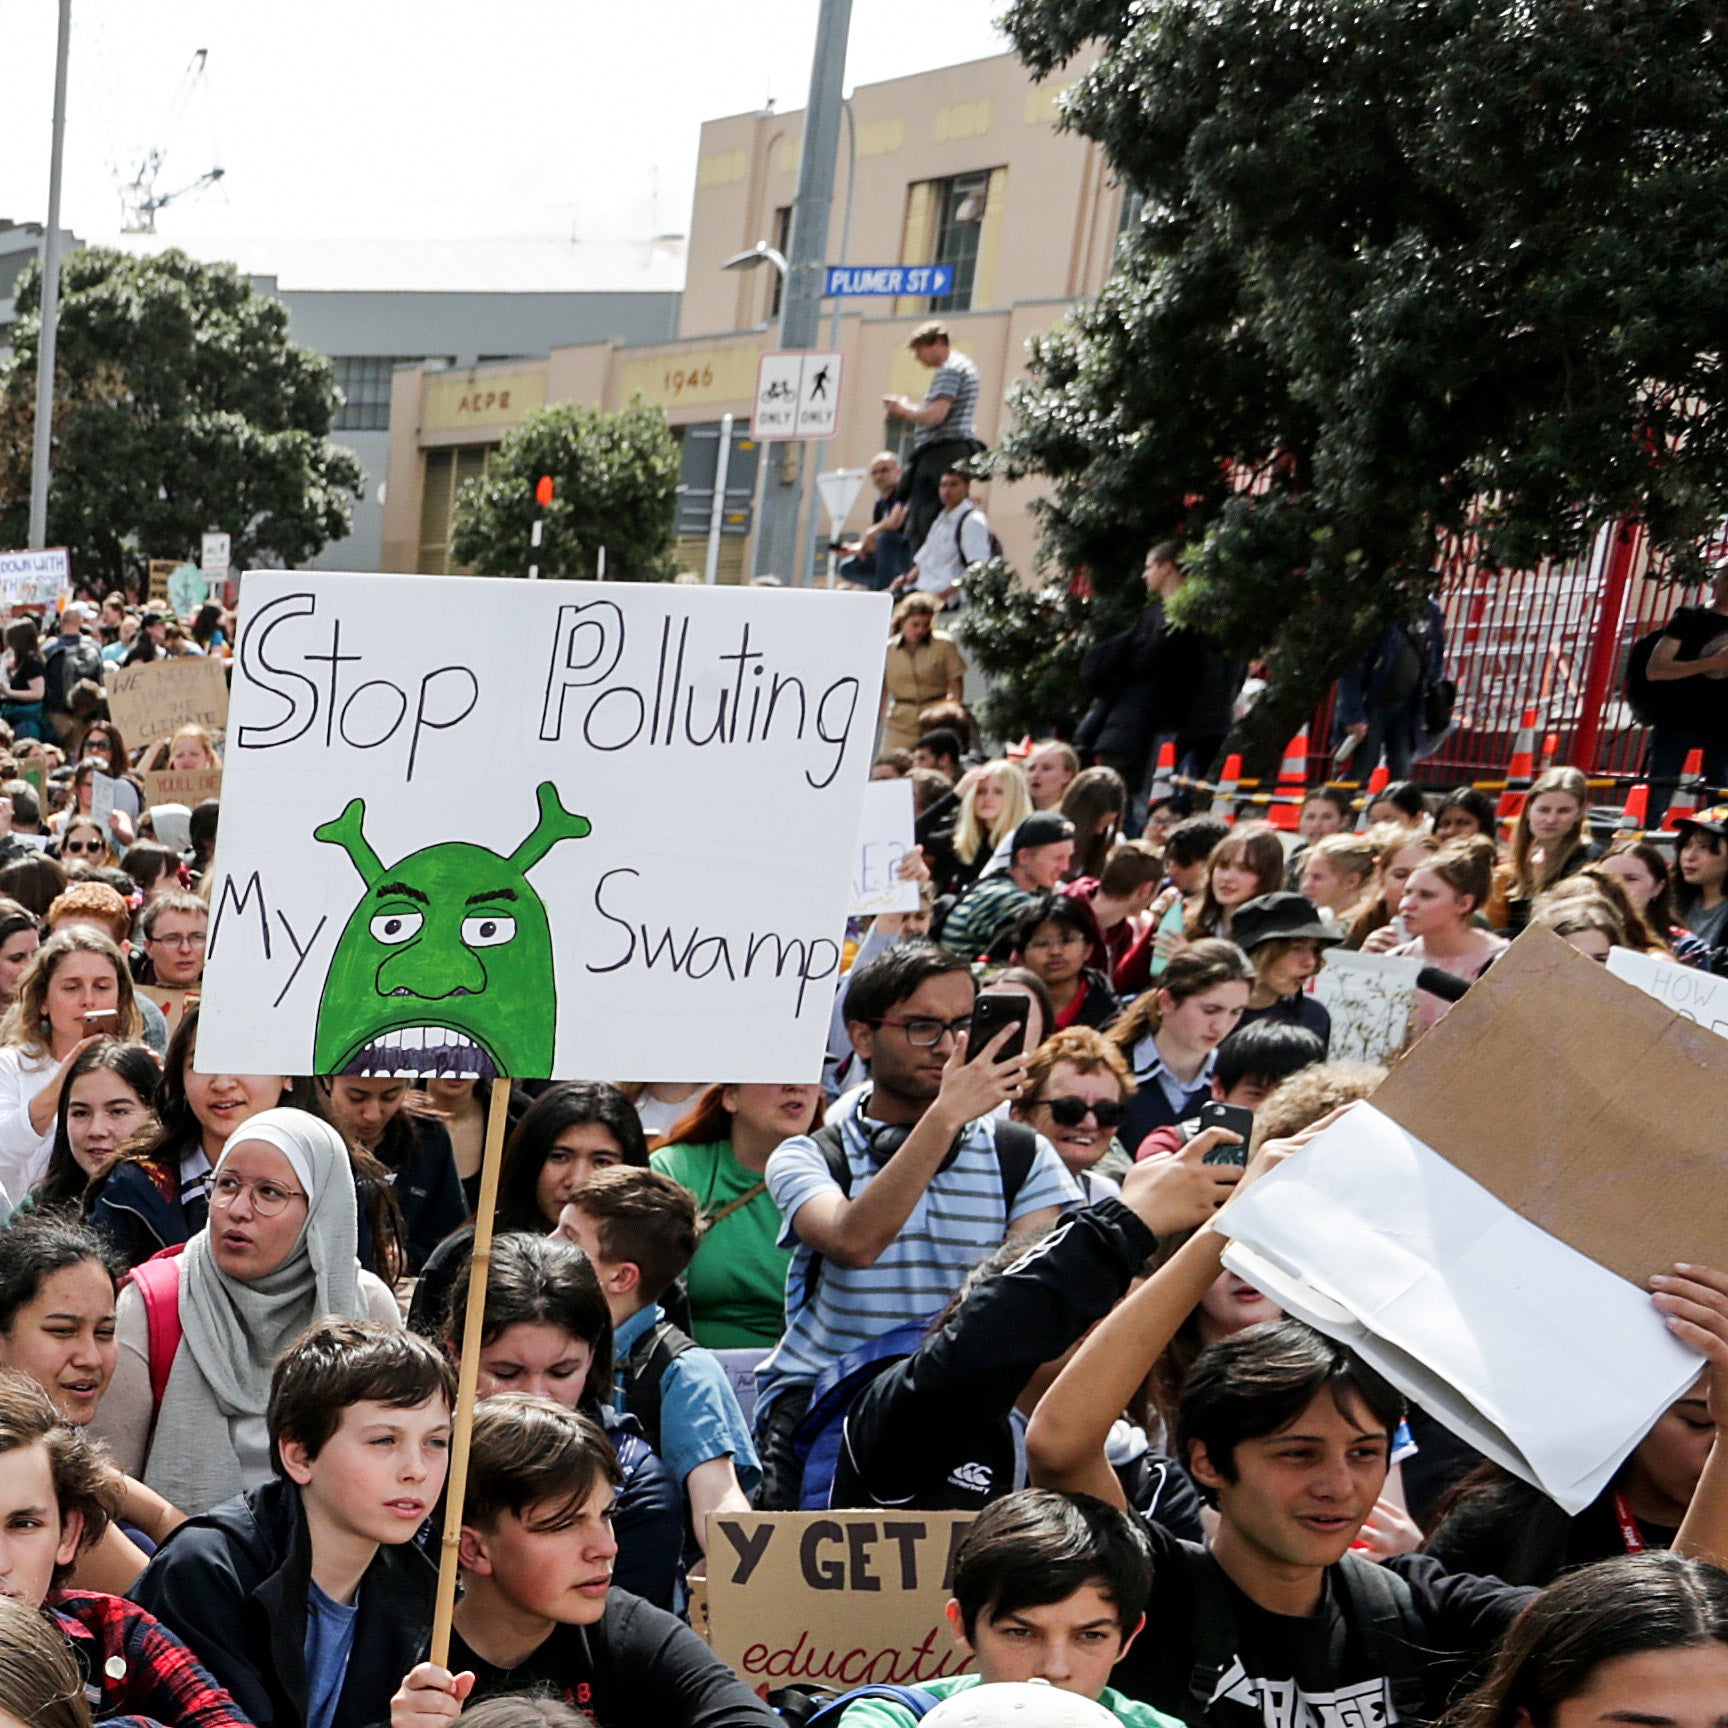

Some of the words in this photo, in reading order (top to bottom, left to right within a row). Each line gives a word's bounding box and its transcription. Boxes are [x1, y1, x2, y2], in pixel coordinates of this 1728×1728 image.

[830, 268, 904, 293] PLUMER
[905, 268, 932, 293] ST
[663, 364, 715, 397] 1946
[758, 411, 793, 426] ONLY
[800, 410, 834, 425] ONLY
[33, 555, 65, 572] WITH
[113, 671, 145, 695] WE
[237, 591, 480, 783] Stop
[538, 599, 861, 790] Polluting
[138, 711, 216, 738] CLIMATE
[206, 869, 328, 1009] My
[585, 866, 840, 1019] Swamp
[1650, 967, 1718, 1007] HOW
[717, 1520, 775, 1585] Y
[799, 1519, 927, 1592] GET
